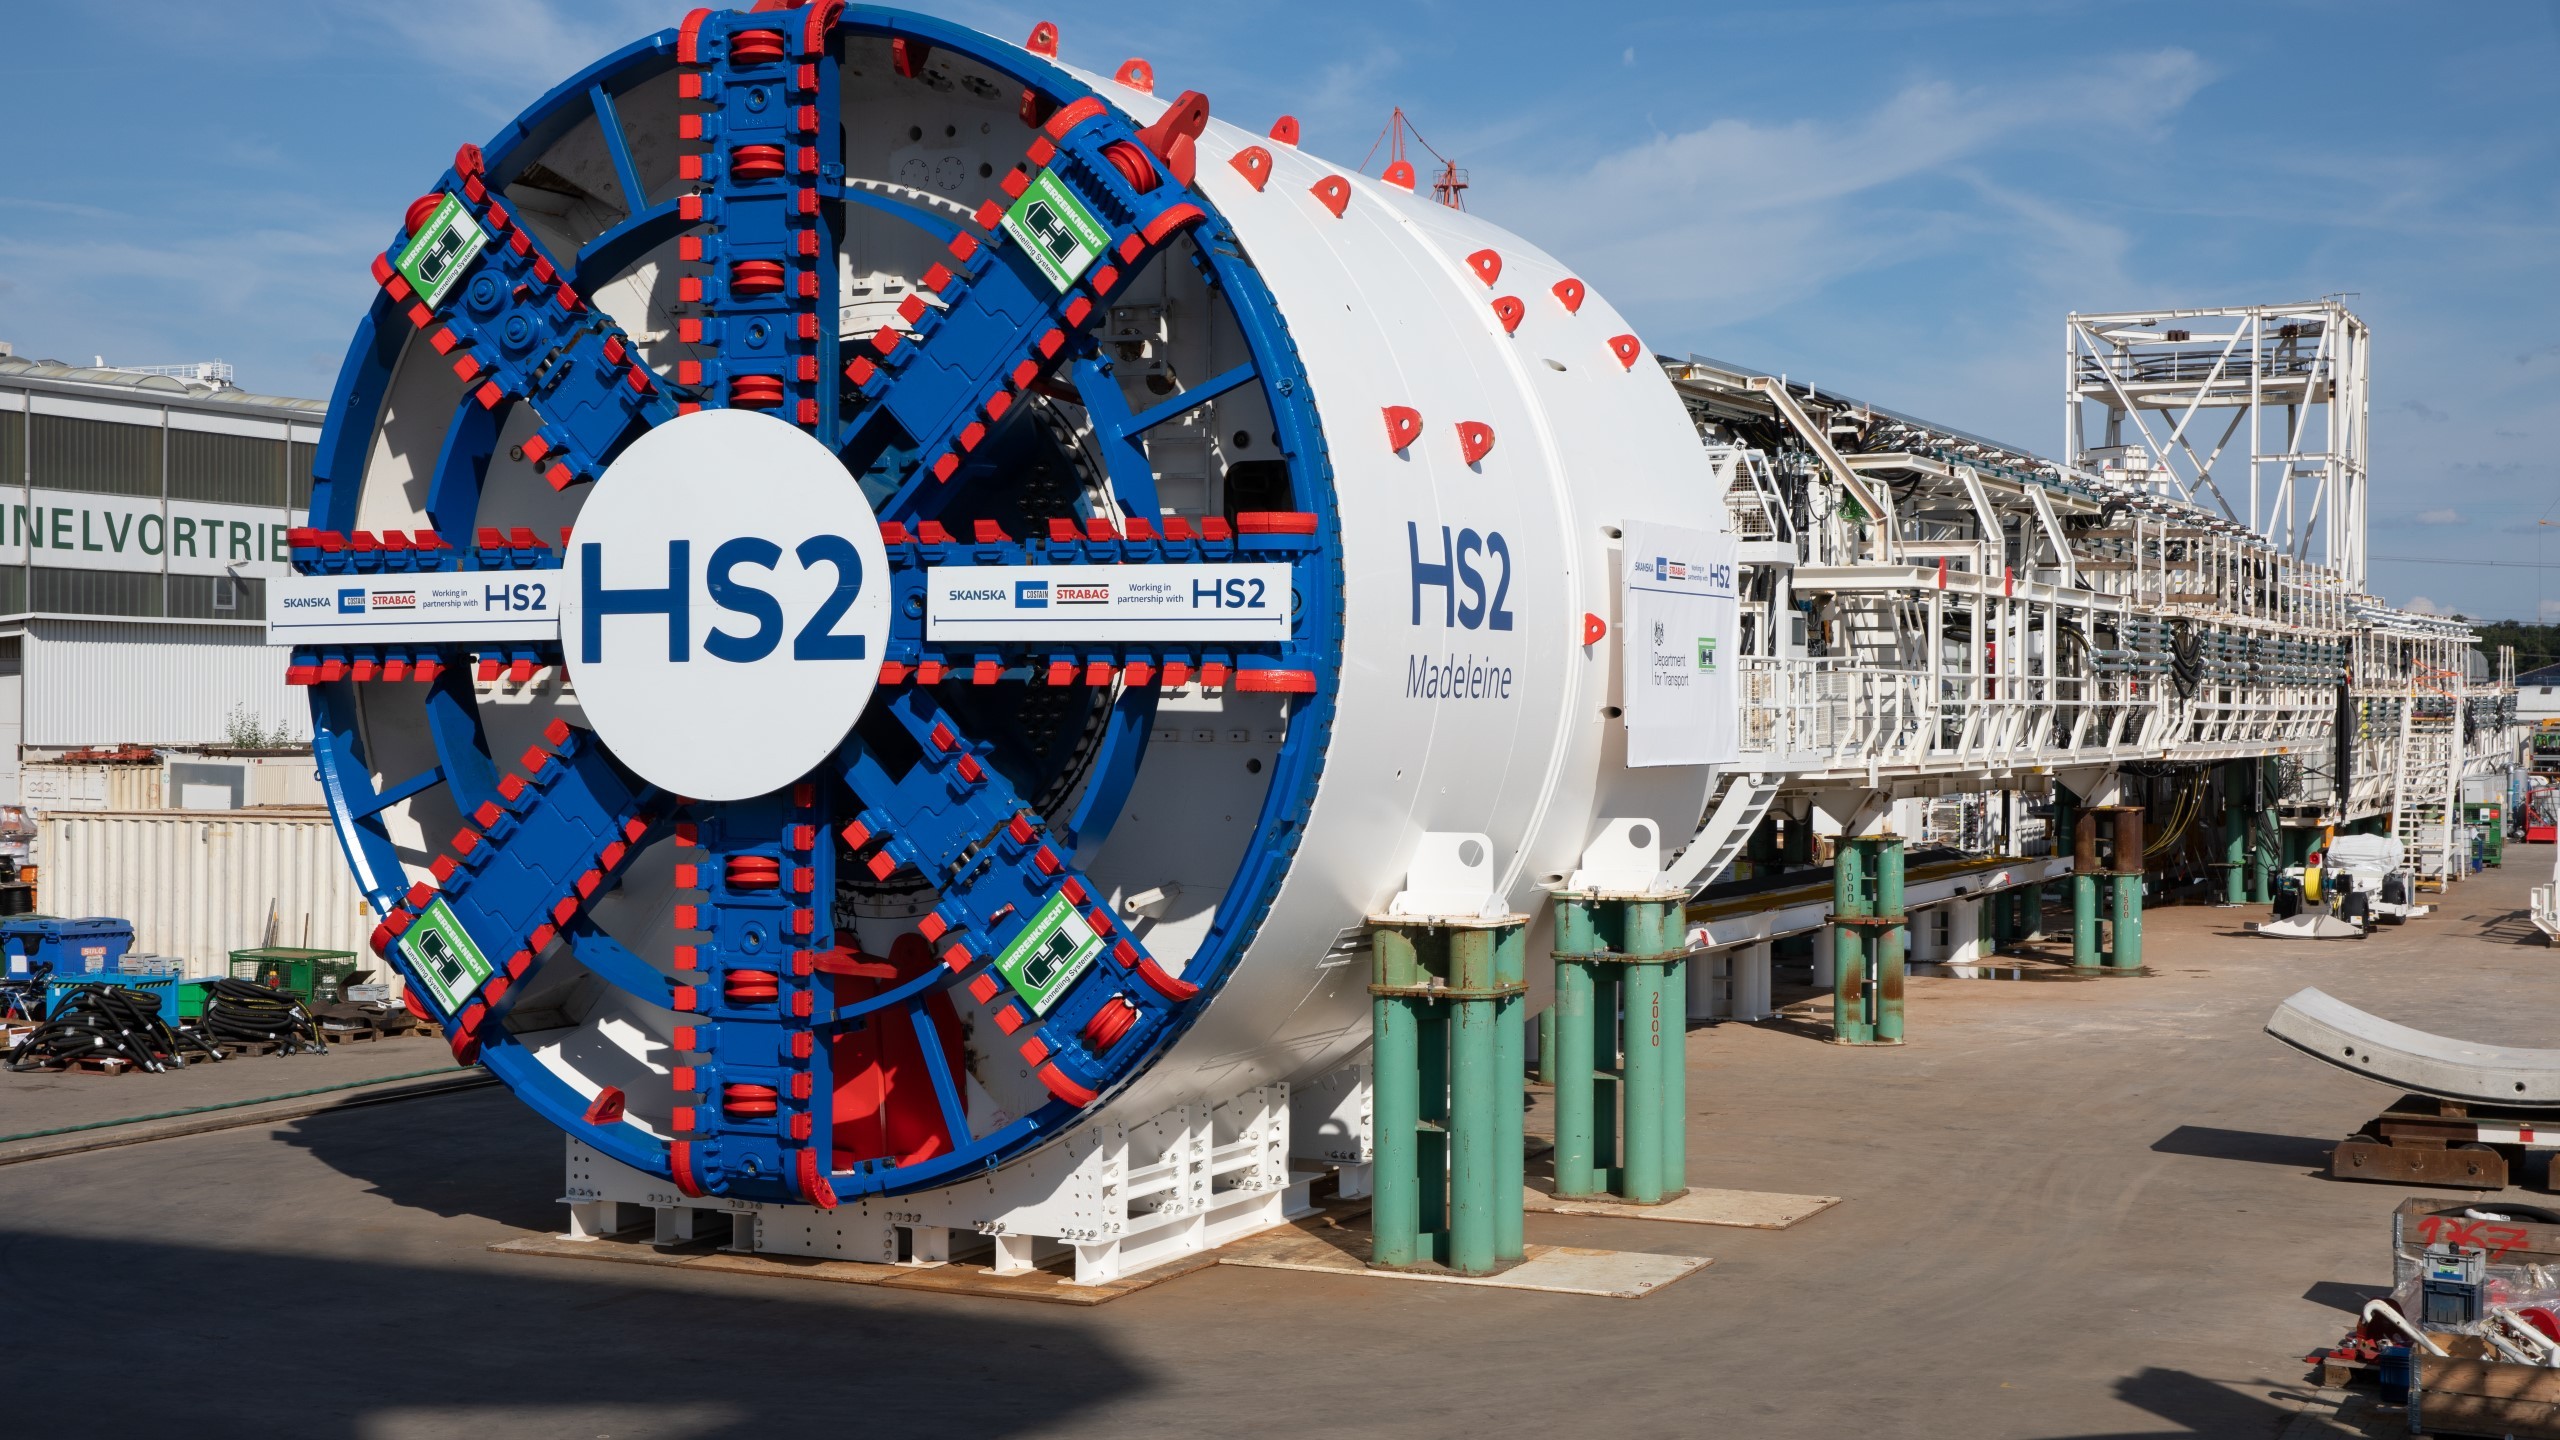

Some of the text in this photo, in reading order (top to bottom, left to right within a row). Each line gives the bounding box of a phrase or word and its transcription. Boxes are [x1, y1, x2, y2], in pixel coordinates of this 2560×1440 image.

[401, 200, 455, 270] HERRENKNECHT
[1039, 177, 1102, 248] HERRENKNECHT
[433, 244, 478, 298] Tunnelling Systems
[1009, 223, 1059, 281] Tunnelling Systems
[0, 503, 307, 562] NELVORTRIE
[283, 597, 331, 608] SKANSKA
[372, 595, 416, 605] STRABAG
[432, 589, 468, 598] Working in
[485, 583, 547, 611] HS2
[581, 534, 866, 664] HS2
[949, 590, 1007, 601] SKANSKA
[1056, 589, 1109, 599] STRABAG
[1117, 594, 1184, 605] partnership with
[1128, 583, 1172, 593] Working in
[1192, 578, 1266, 608] HS2
[1407, 521, 1513, 631] HS2
[1710, 563, 1730, 588] HS2
[422, 599, 479, 609] partnership with
[1406, 653, 1512, 699] Madeleine
[1654, 651, 1686, 669] Department
[432, 907, 485, 977] HERRENKNECHT
[1002, 901, 1066, 972] HERRENKNECHT
[406, 946, 447, 1003] Tunnelling Systems
[1041, 950, 1094, 1006] Tunnelling Systems
[1651, 991, 1660, 1047] 2000
